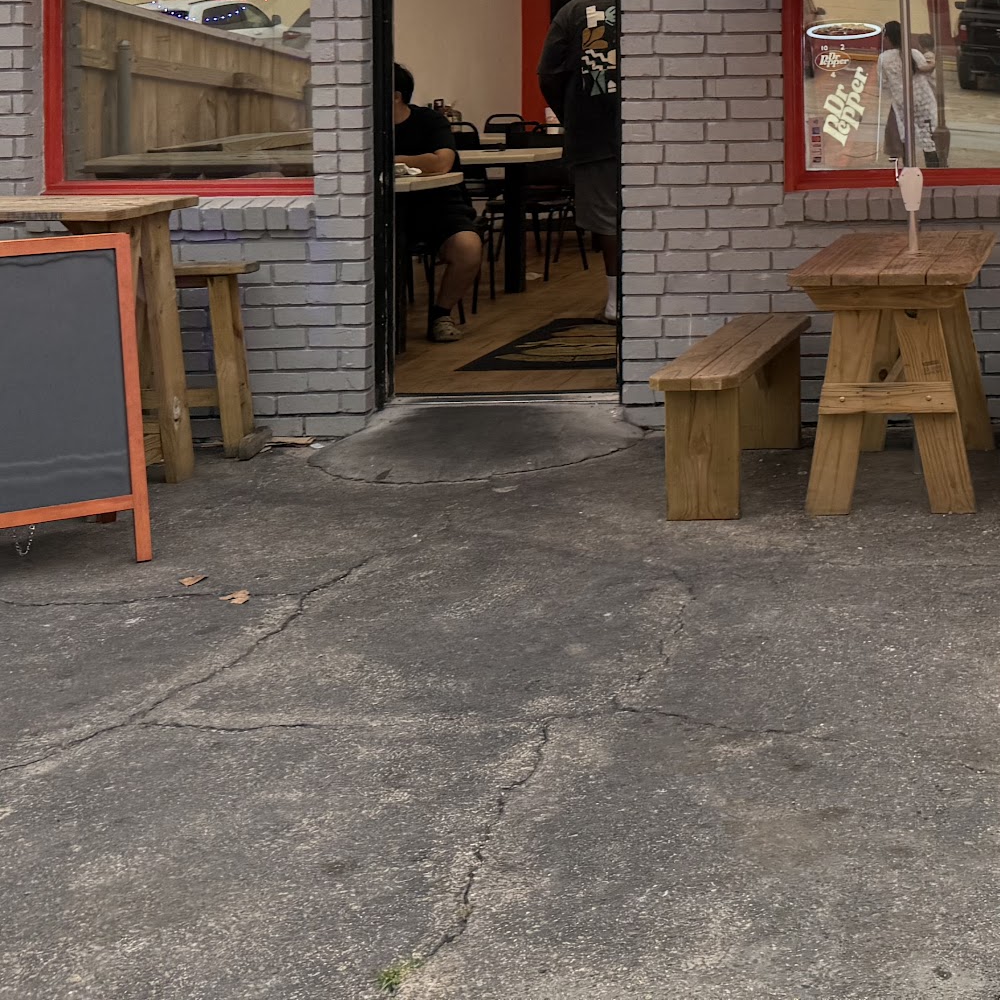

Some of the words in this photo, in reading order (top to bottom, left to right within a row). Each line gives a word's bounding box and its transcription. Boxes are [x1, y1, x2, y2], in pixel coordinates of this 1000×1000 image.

[840, 43, 846, 51] 2
[819, 54, 850, 68] Pepper
[829, 52, 841, 61] Dr
[823, 83, 849, 114] Dr
[823, 66, 868, 147] Pepper
